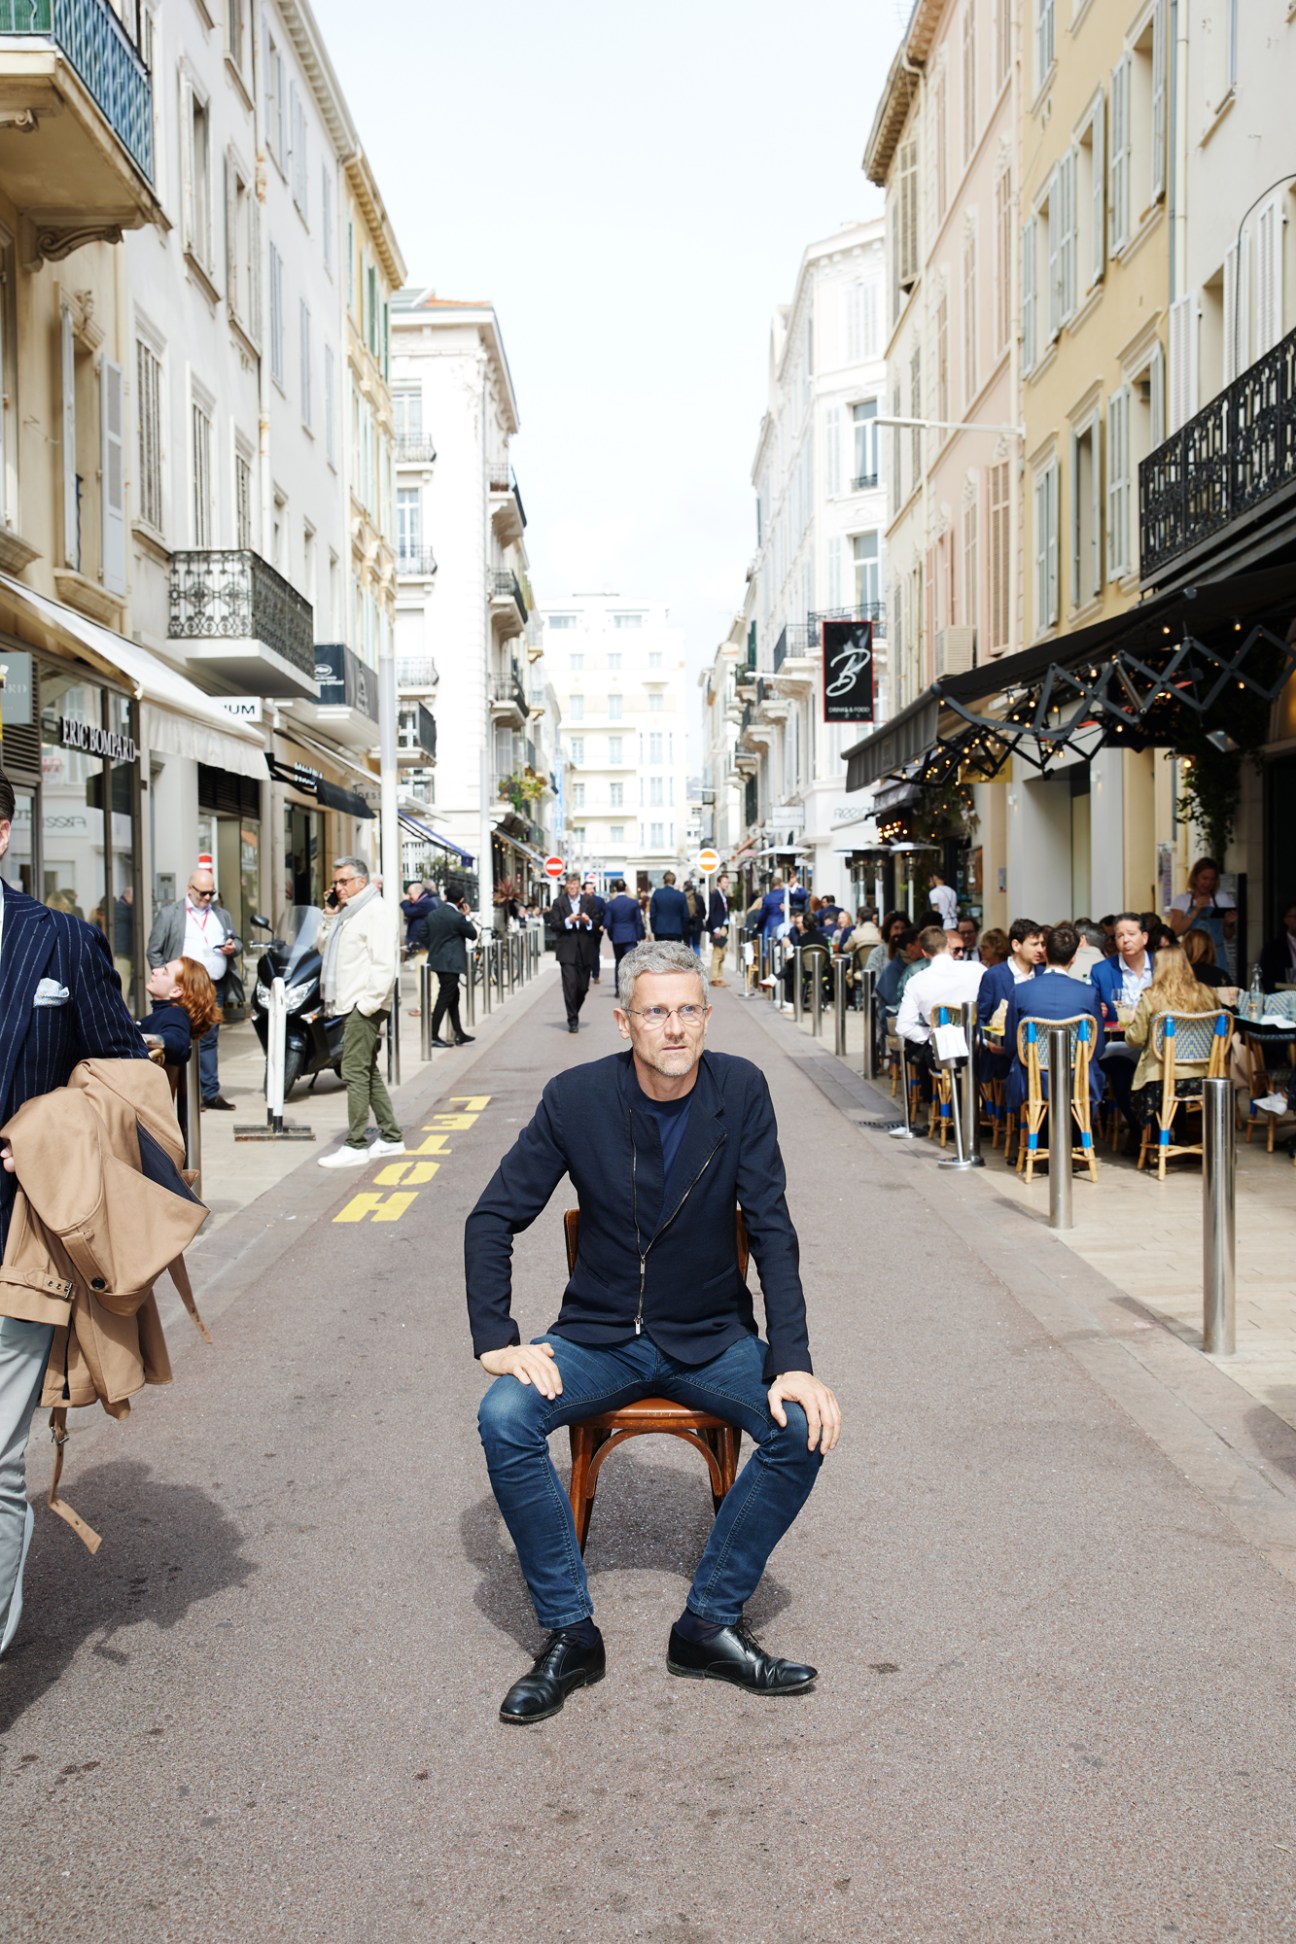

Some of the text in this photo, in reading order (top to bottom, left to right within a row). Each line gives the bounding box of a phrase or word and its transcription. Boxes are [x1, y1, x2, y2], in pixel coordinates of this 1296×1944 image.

[61, 716, 136, 762] ERIC BOMPARD
[331, 1095, 493, 1223] HOTEL
